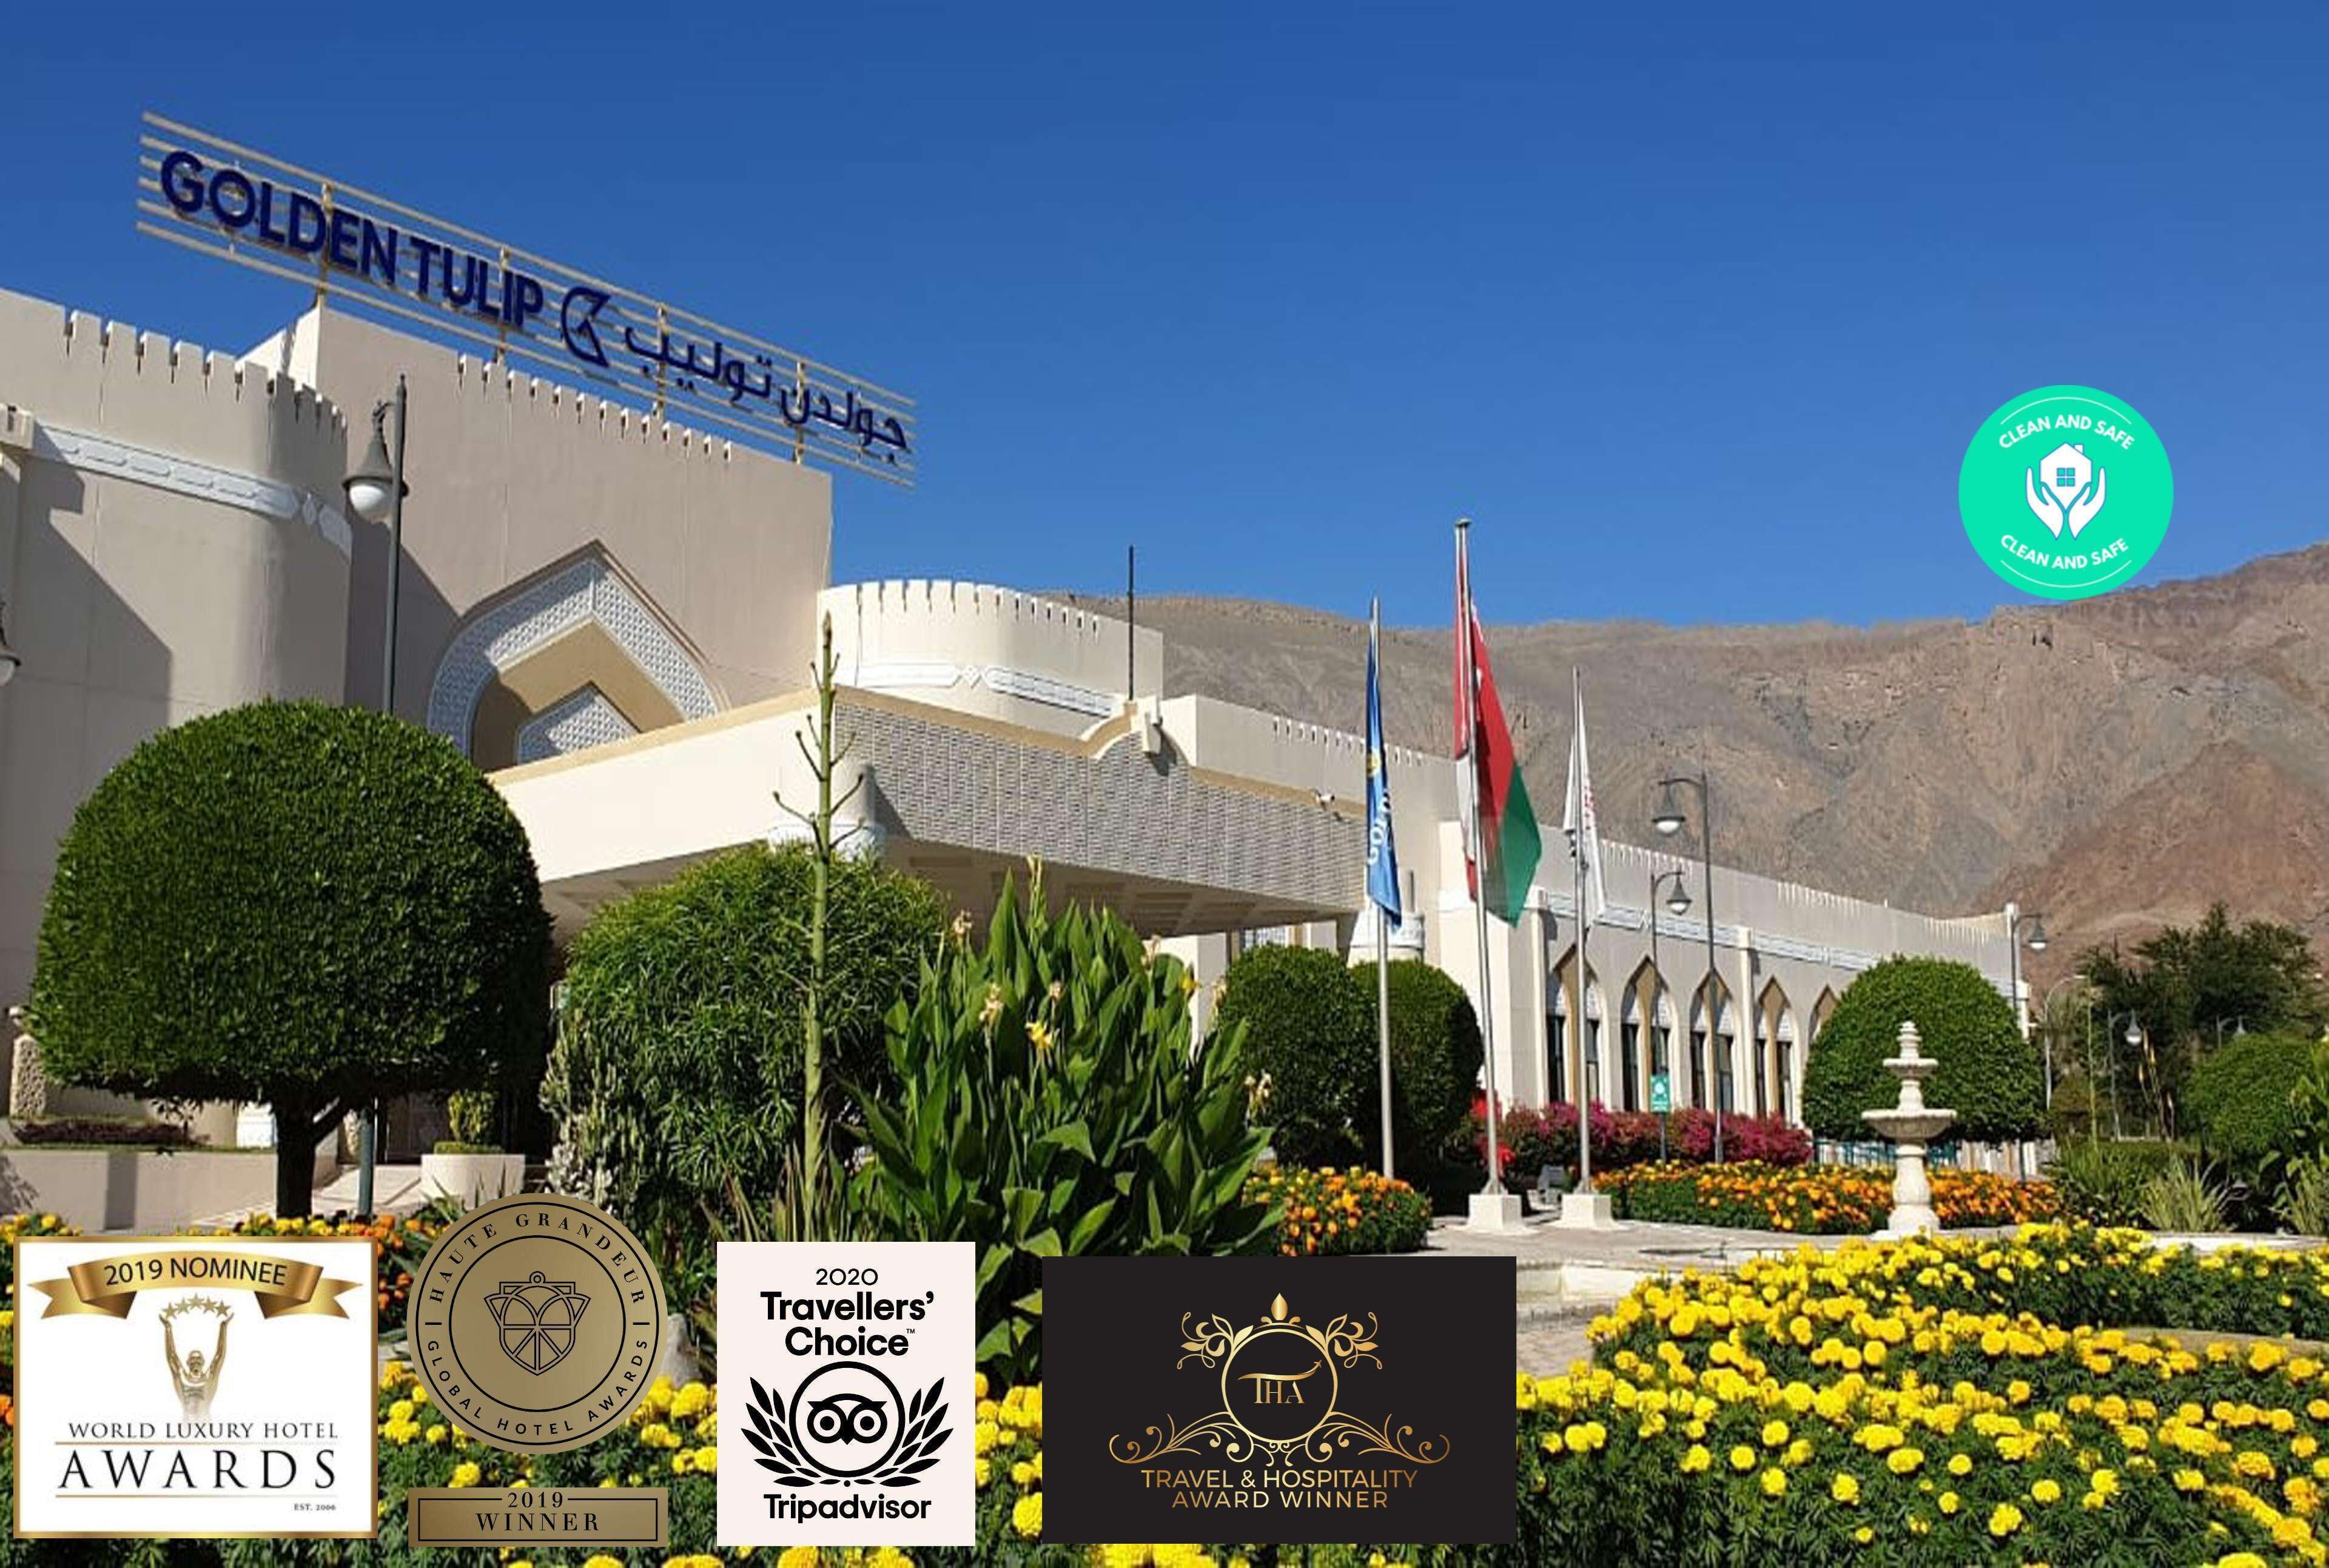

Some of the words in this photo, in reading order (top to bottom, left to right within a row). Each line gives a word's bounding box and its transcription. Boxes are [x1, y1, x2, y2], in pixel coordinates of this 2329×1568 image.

[161, 150, 398, 285] GOLDEN
[409, 236, 544, 328] TULIP
[625, 326, 772, 403] توليب
[781, 387, 907, 464] جولدن
